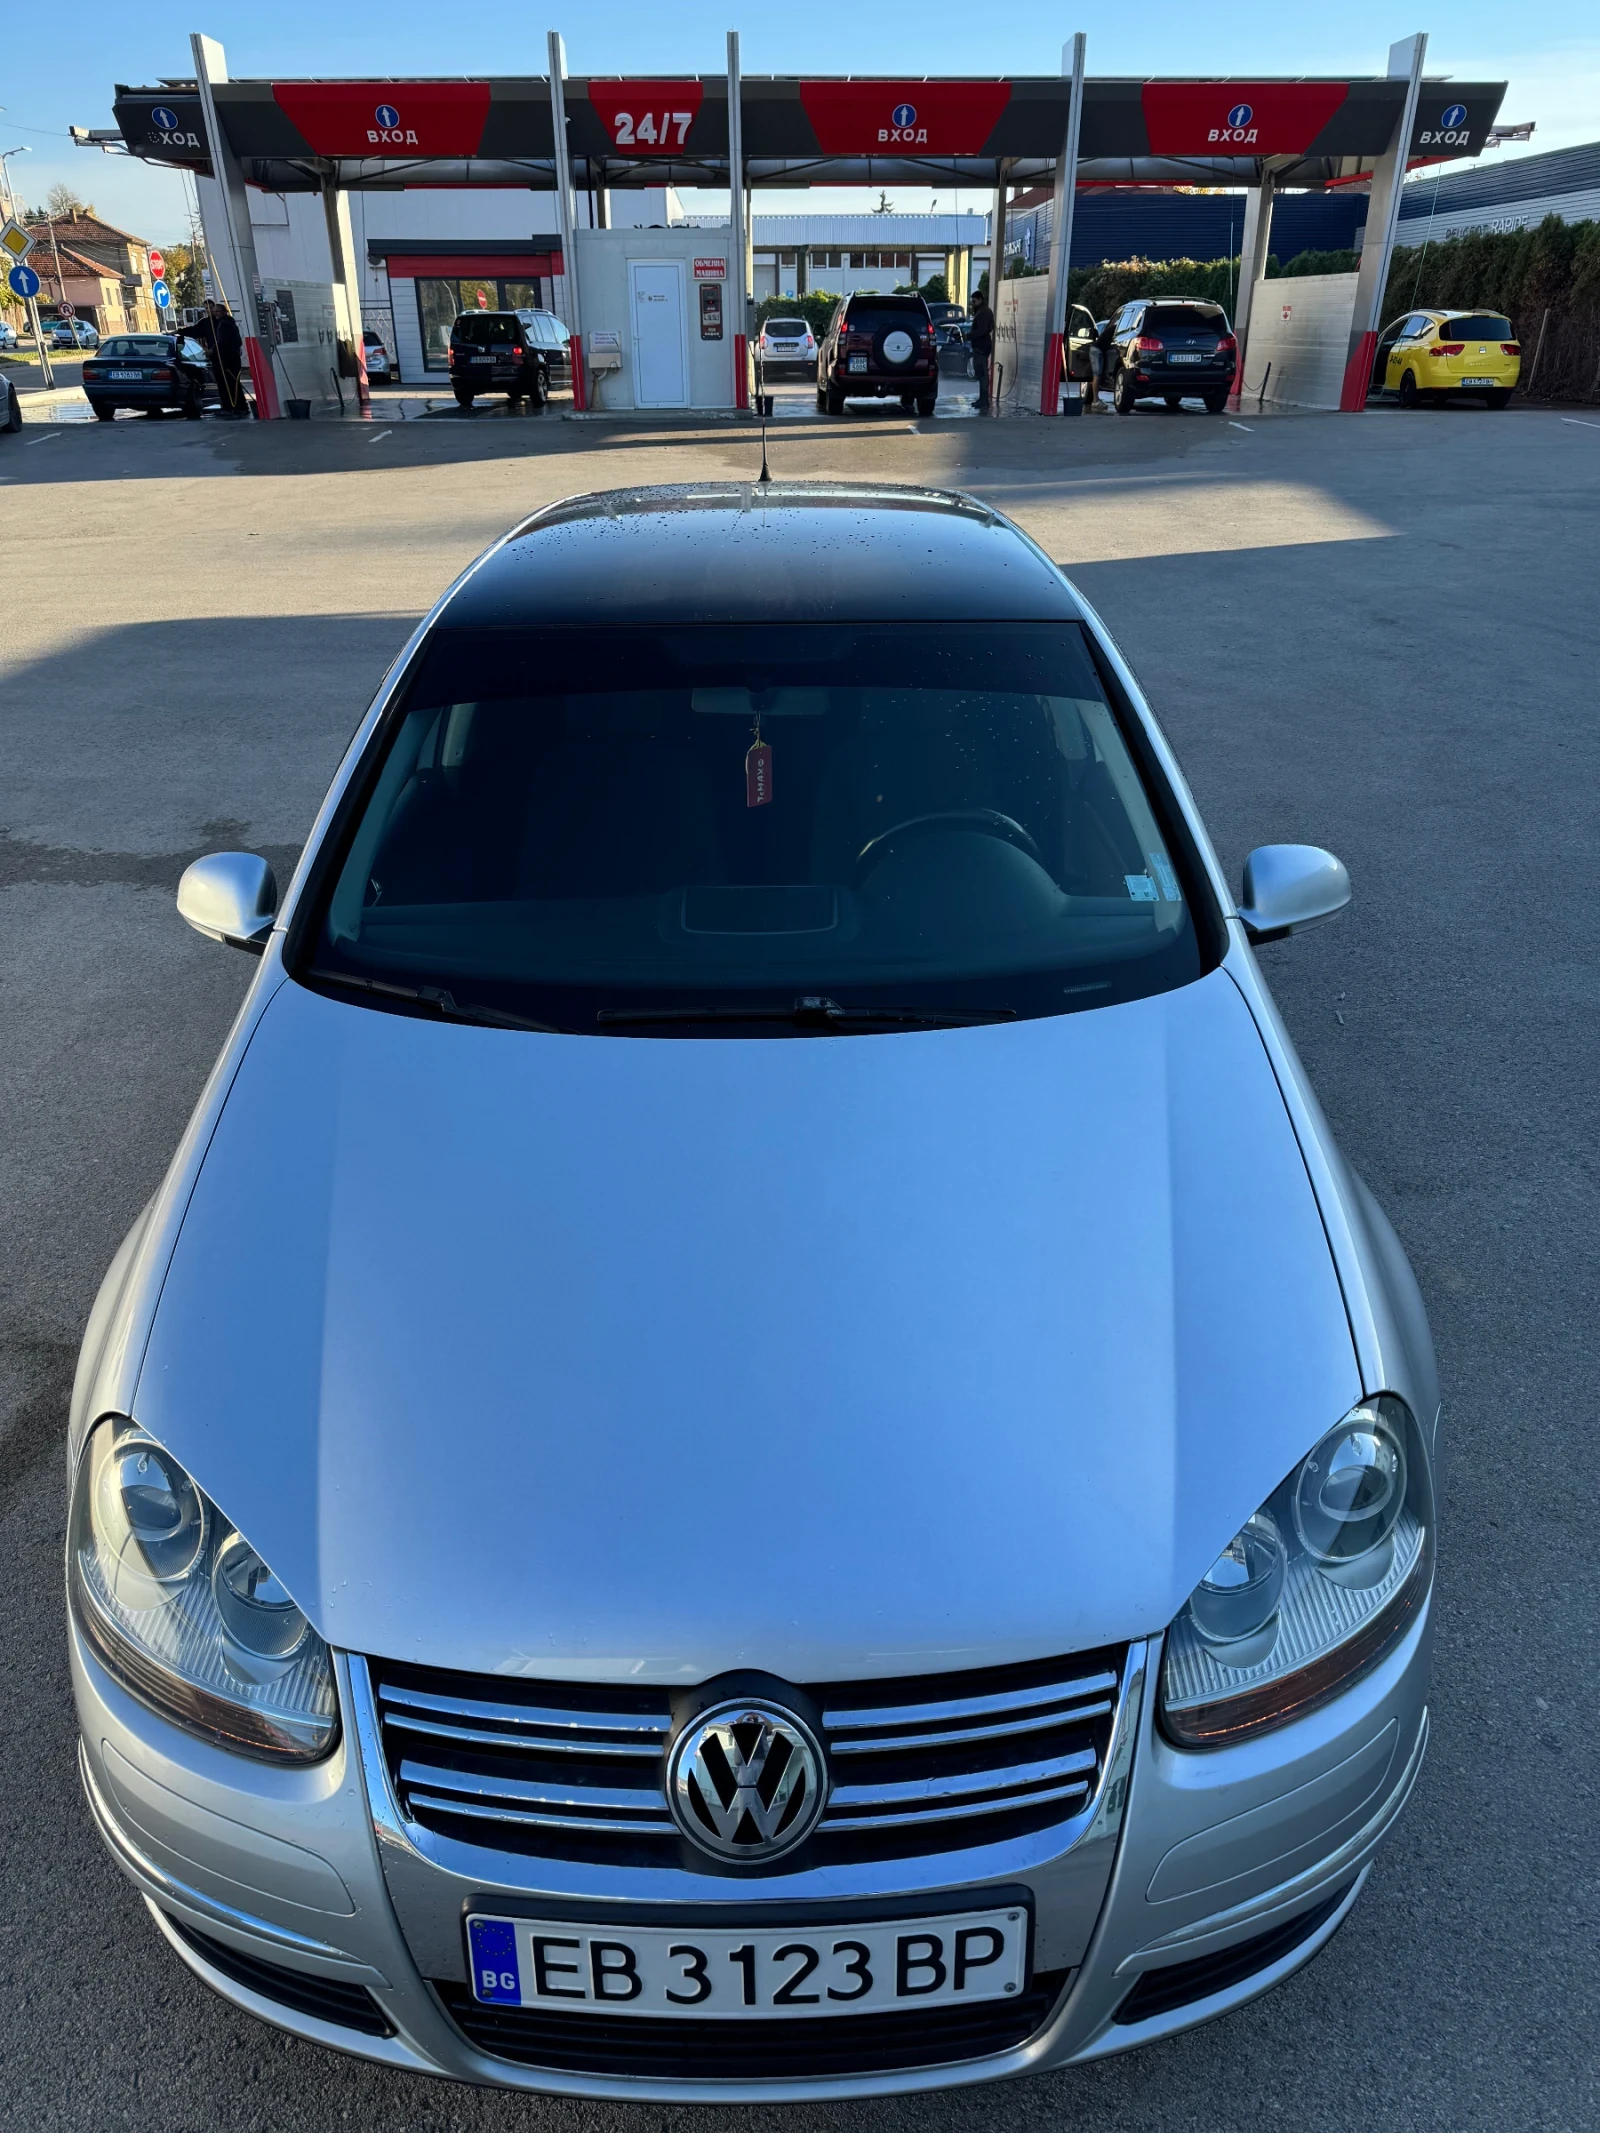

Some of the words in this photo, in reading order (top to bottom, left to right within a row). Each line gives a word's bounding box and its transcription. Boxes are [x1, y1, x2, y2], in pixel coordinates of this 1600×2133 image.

[614, 112, 692, 145] 24/7
[877, 128, 928, 144] ВХОД
[1207, 128, 1259, 144] ВХОД
[366, 129, 419, 145] ВХОД
[1418, 130, 1470, 146] ВХОД
[150, 259, 164, 270] STOP
[694, 259, 725, 268] ОБМЕННА
[695, 269, 725, 277] МАШИНА
[530, 1934, 643, 2001] EB
[664, 1940, 874, 2005] 3123
[895, 1926, 1005, 1997] BP
[482, 1970, 516, 1990] BG
